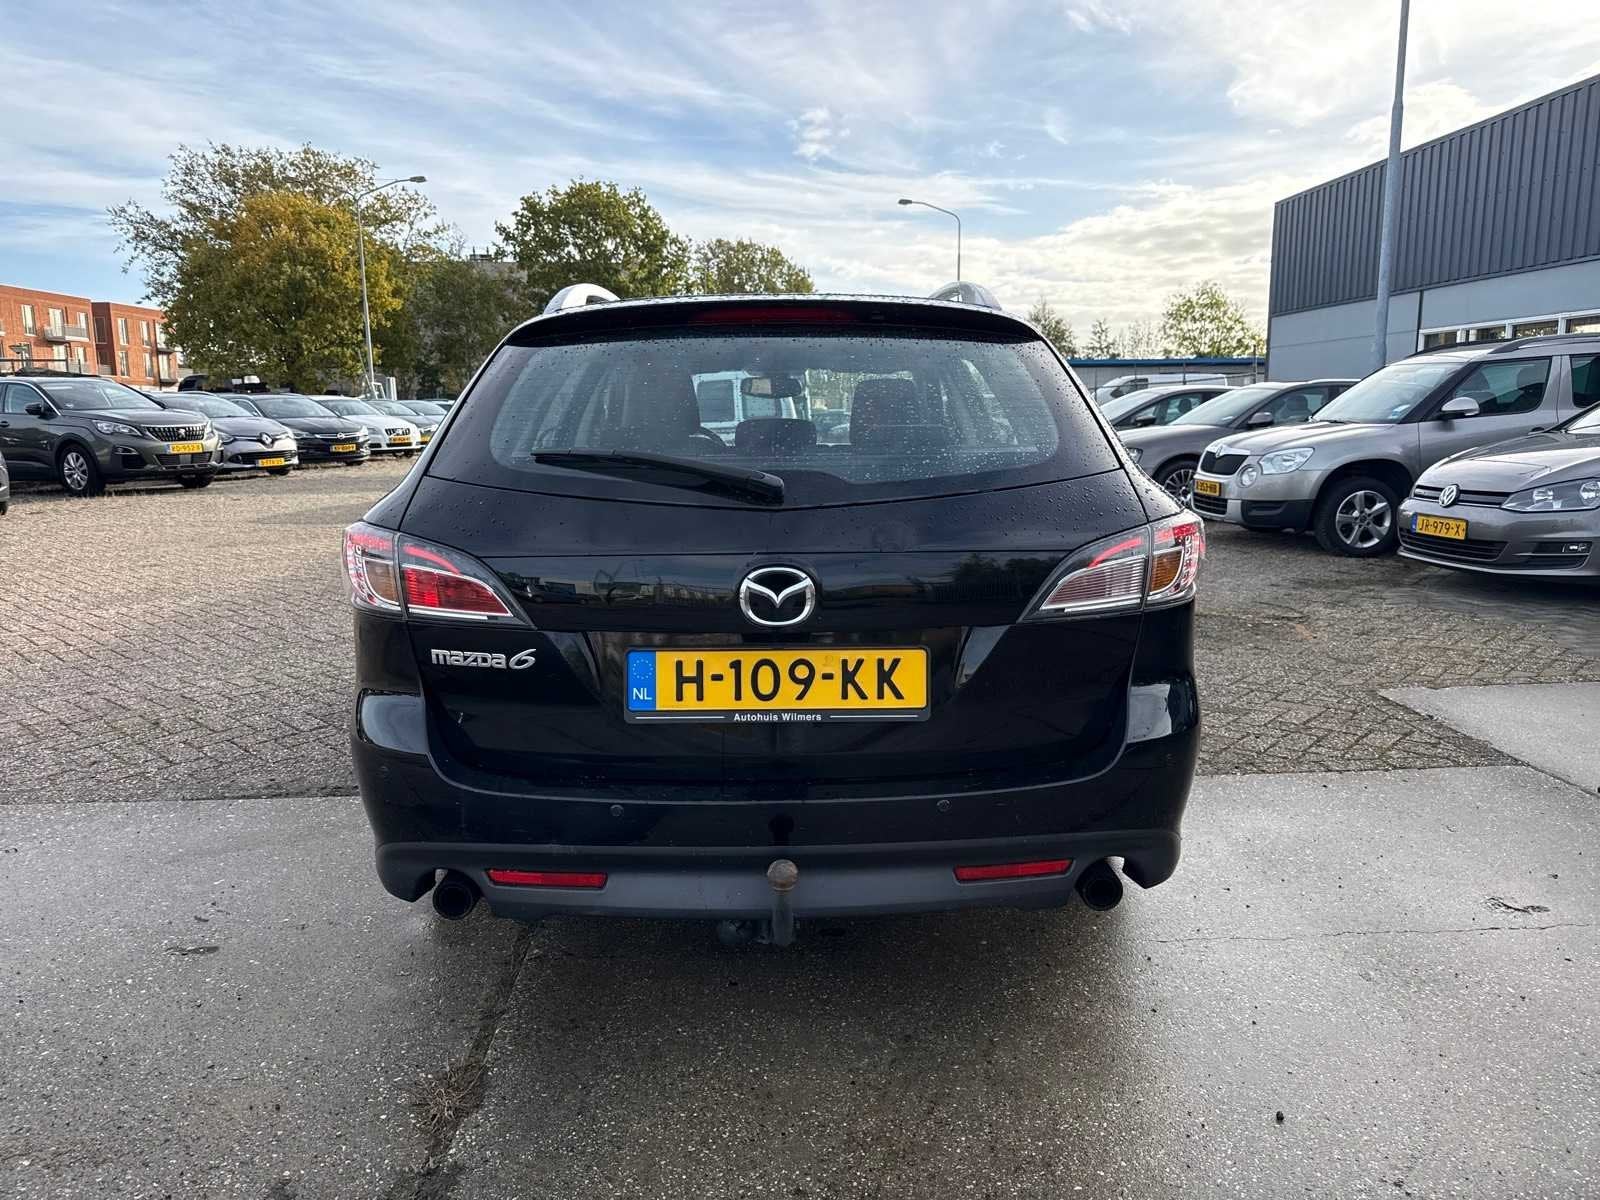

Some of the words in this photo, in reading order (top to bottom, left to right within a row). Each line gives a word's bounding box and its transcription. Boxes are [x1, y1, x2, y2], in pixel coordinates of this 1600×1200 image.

[1419, 518, 1460, 536] JR-979-X
[675, 658, 905, 702] H-109-KK
[632, 688, 652, 700] NL
[733, 713, 779, 721] Autohuis
[782, 712, 822, 721] Wilmers
